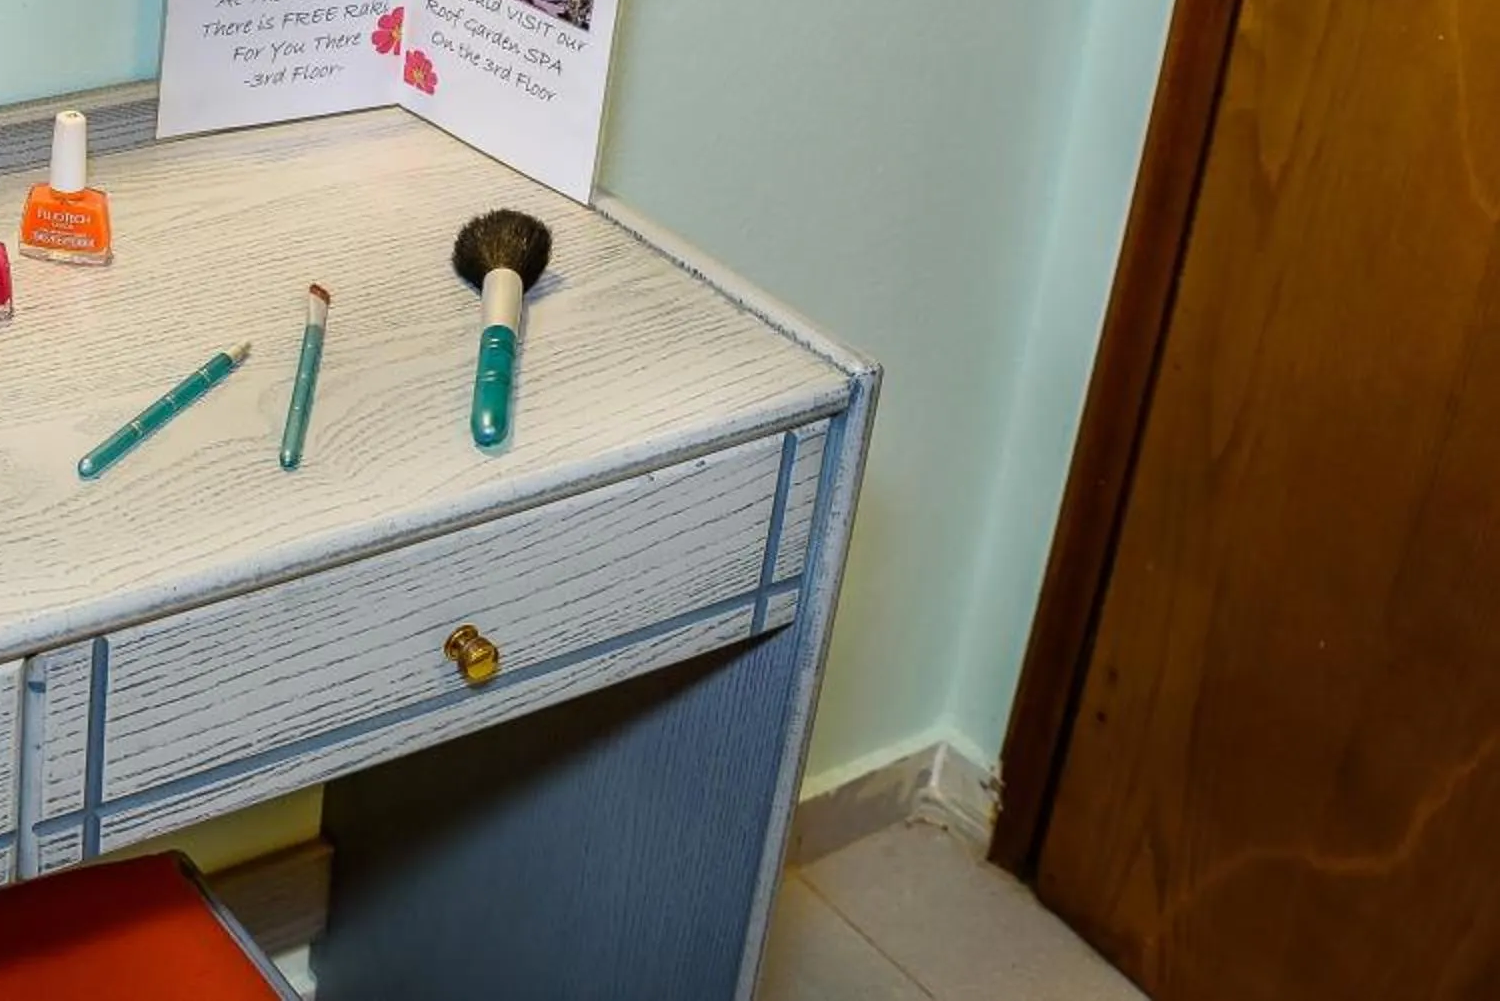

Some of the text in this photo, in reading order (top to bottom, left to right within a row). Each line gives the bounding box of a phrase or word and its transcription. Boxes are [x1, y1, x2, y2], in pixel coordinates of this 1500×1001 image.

[202, 18, 252, 38] There
[257, 12, 275, 31] is
[281, 7, 338, 28] FREE
[507, 5, 557, 37] VISIT
[556, 32, 589, 52] our
[232, 31, 362, 63] For You There
[430, 31, 559, 102] On the 3rd Floor
[463, 18, 521, 55] Garden
[523, 48, 563, 76] SPA
